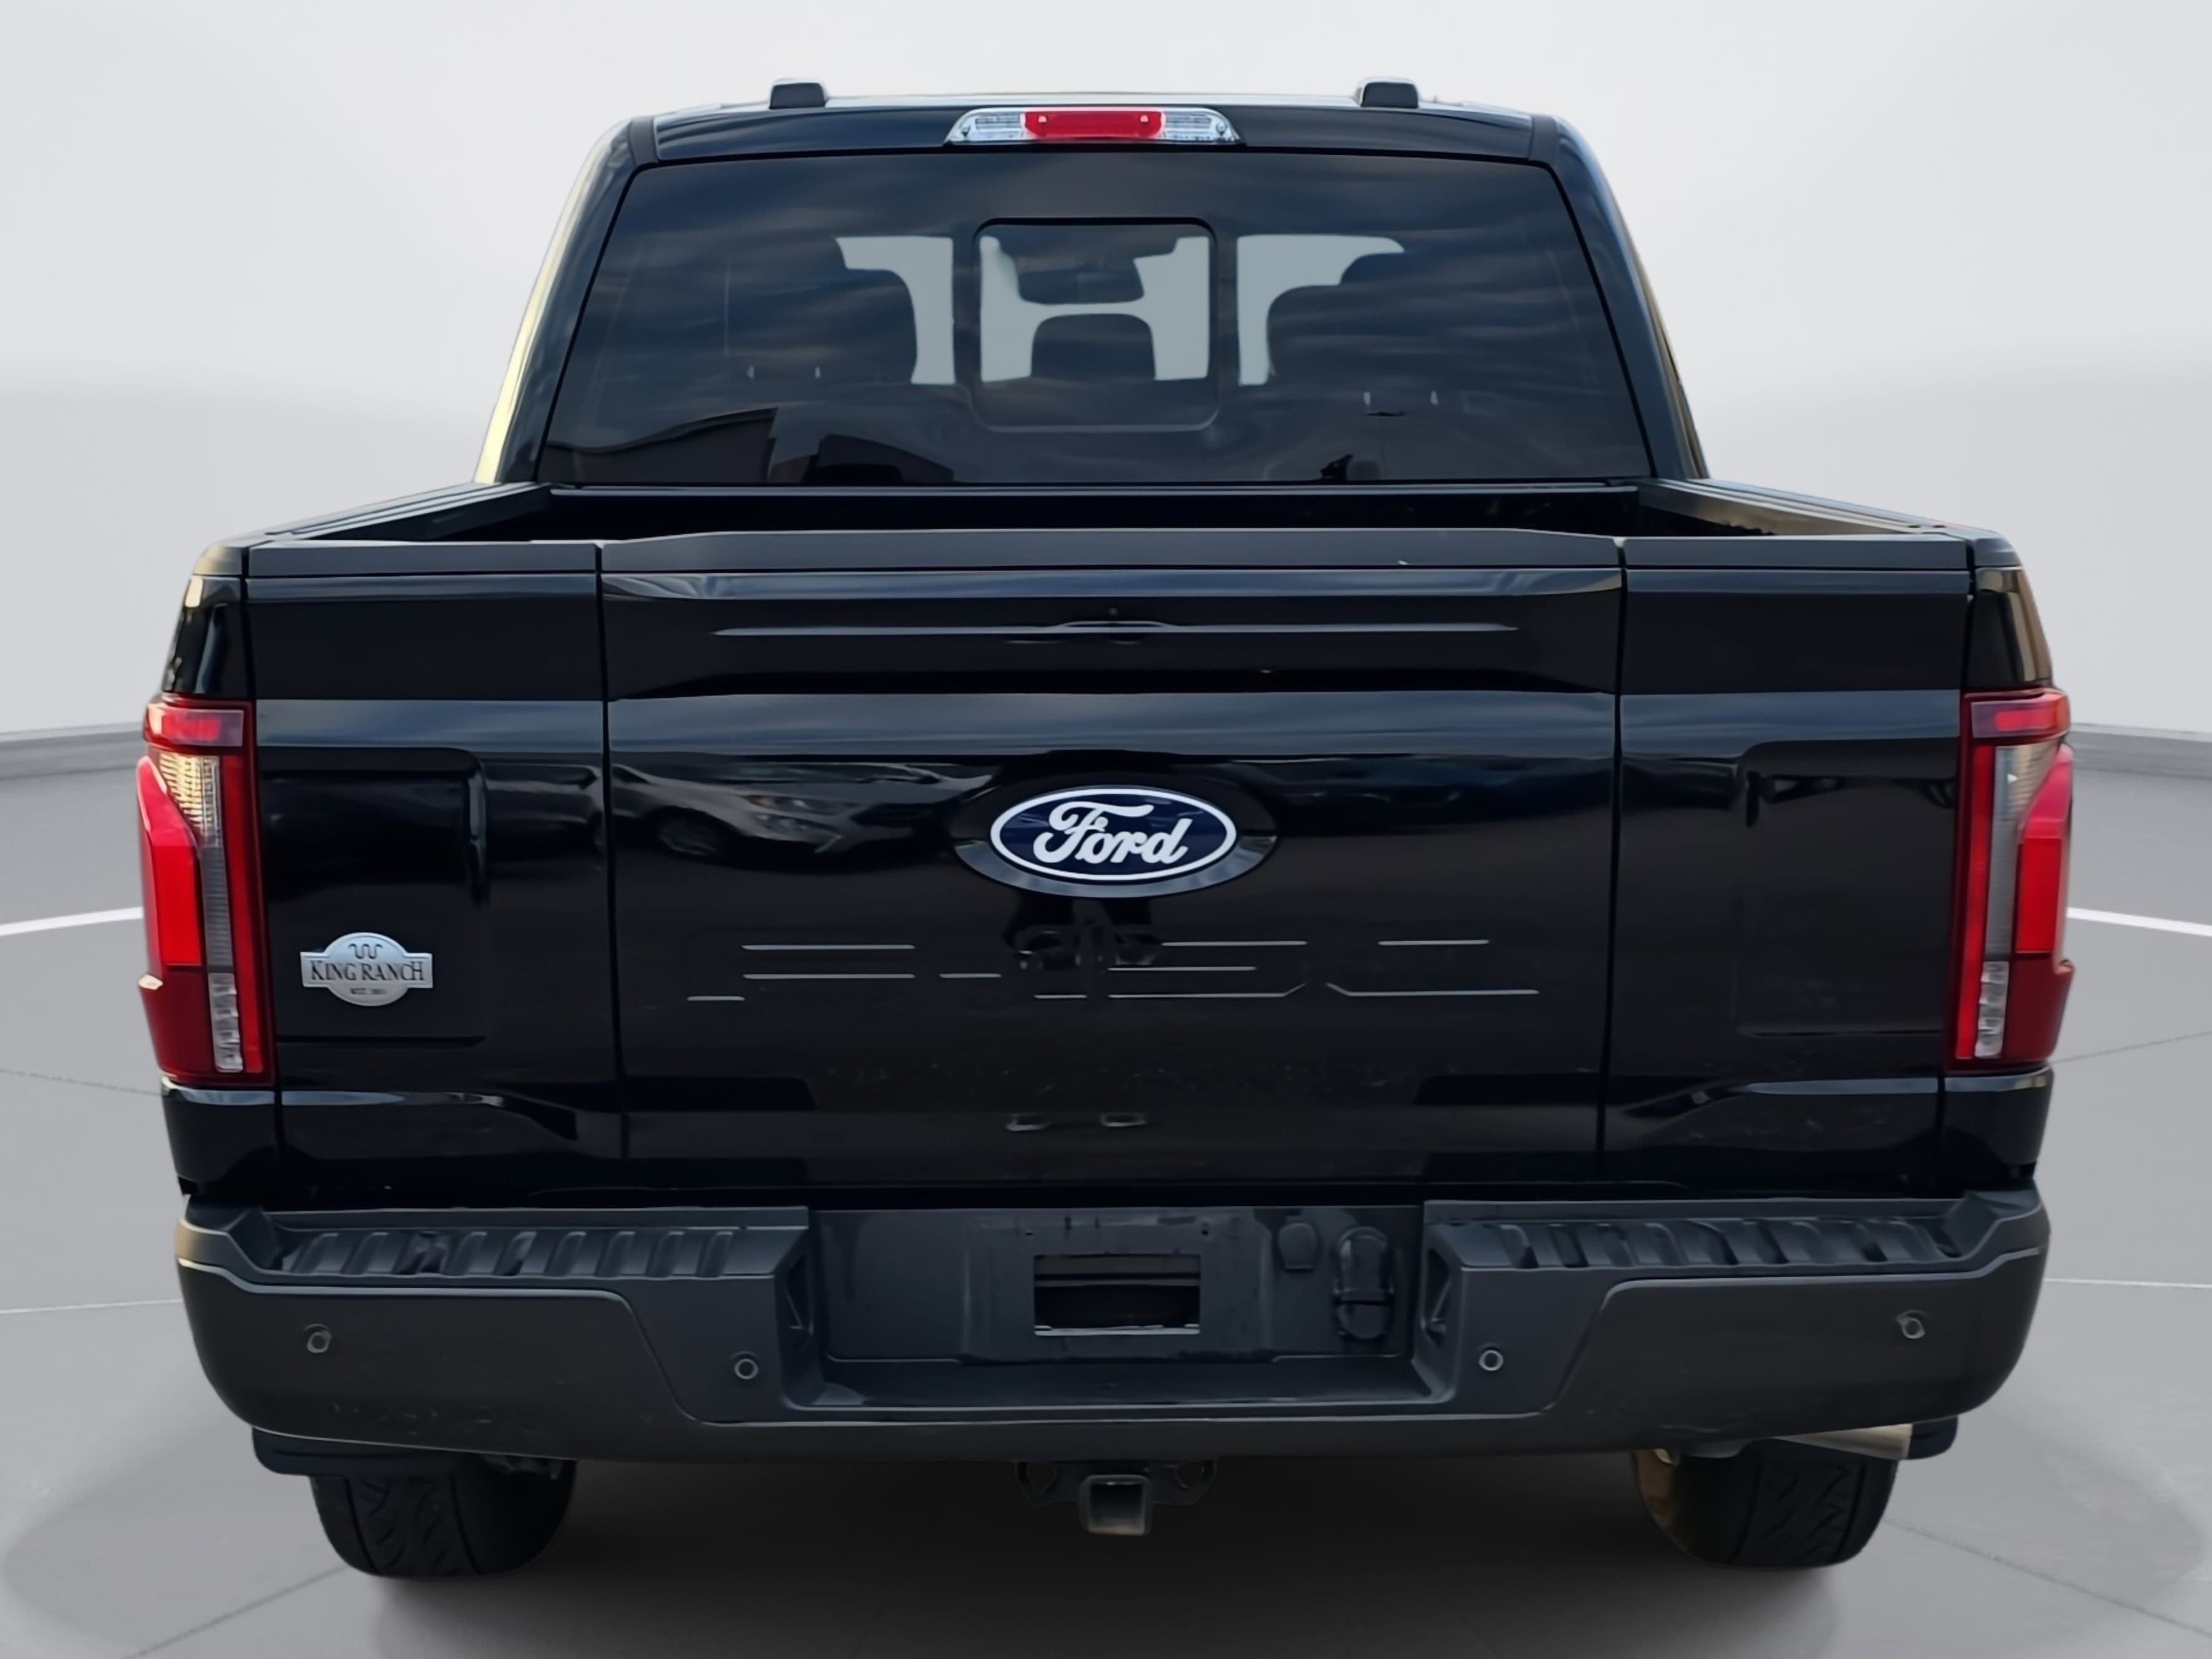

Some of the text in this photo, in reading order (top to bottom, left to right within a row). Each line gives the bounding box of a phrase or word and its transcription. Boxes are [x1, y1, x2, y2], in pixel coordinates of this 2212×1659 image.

[1032, 801, 1194, 864] Ford
[309, 960, 424, 981] KING RANCH
